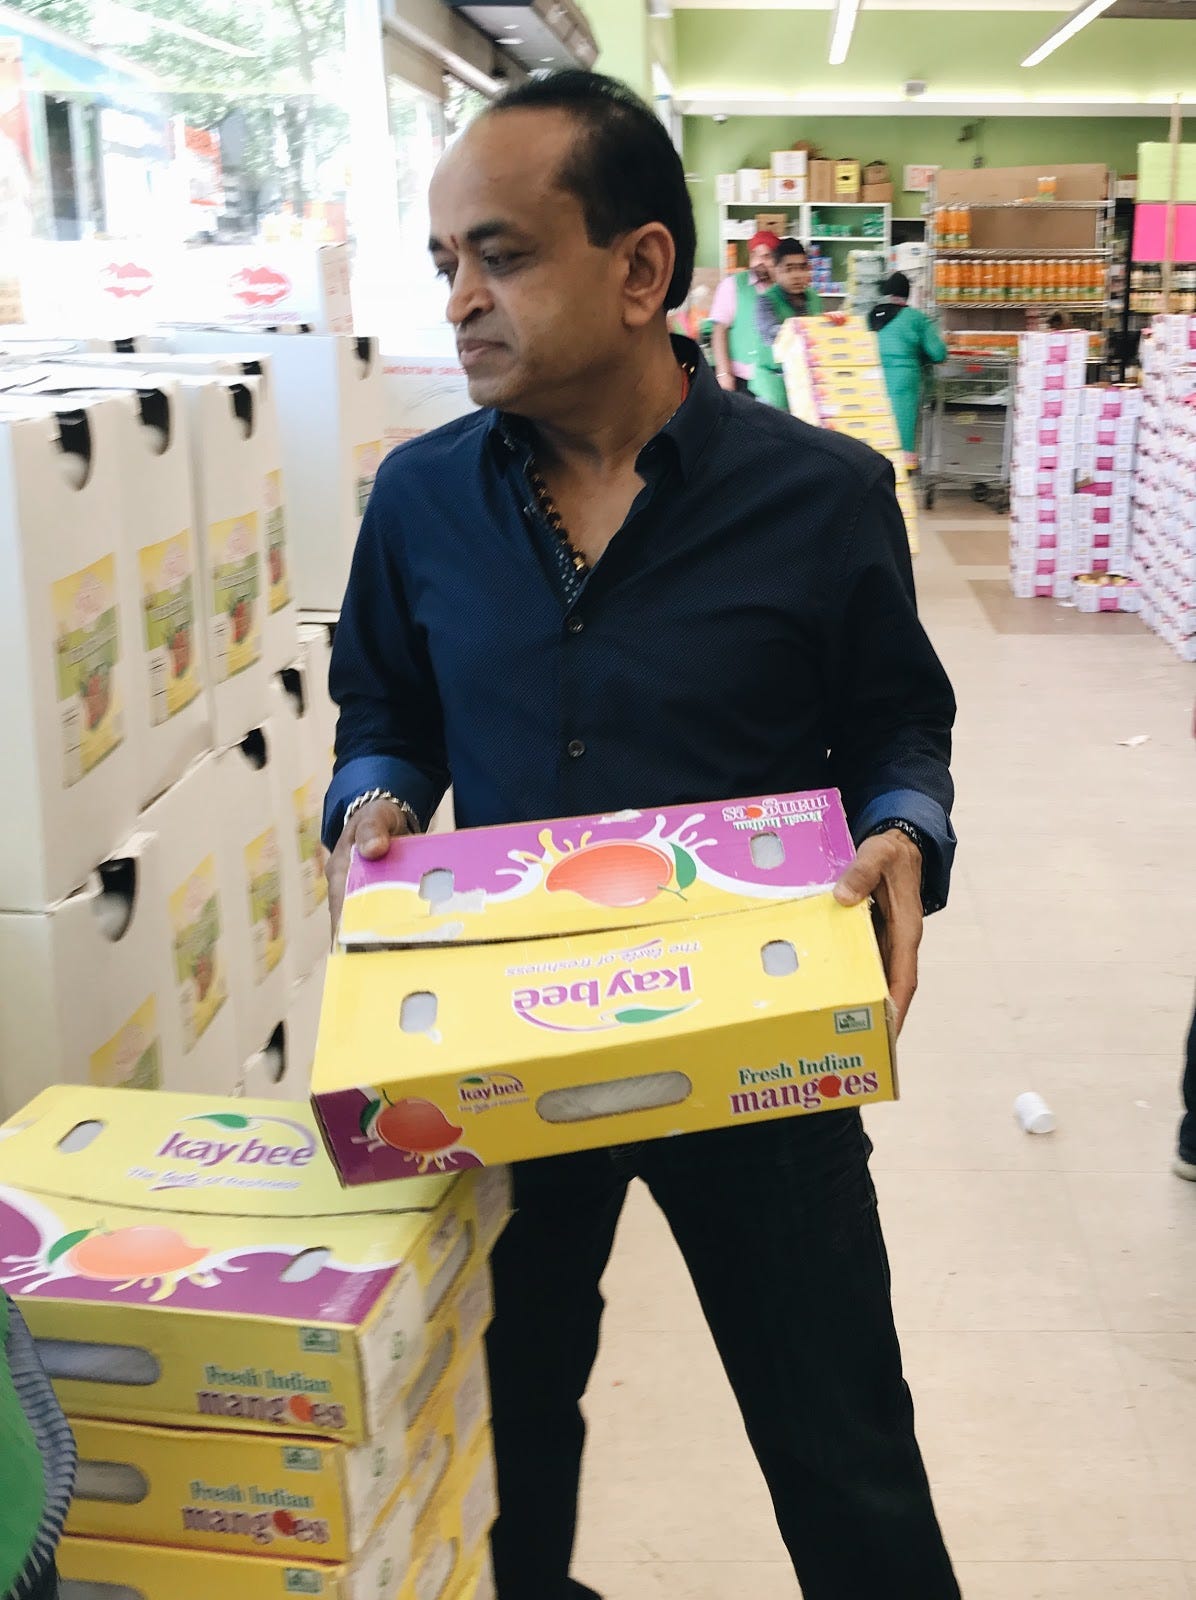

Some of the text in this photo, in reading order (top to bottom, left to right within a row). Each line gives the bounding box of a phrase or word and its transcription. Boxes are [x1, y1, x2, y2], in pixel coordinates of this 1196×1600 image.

[513, 966, 692, 1010] kay bee
[738, 1053, 863, 1086] Fresh Indian
[459, 1087, 491, 1101] kay
[729, 1070, 879, 1115] mangoes
[156, 1131, 316, 1167] kay bee
[204, 1363, 332, 1394] Fresh Indian
[196, 1390, 347, 1430] mangoes
[189, 1479, 315, 1511] Fresh Indian
